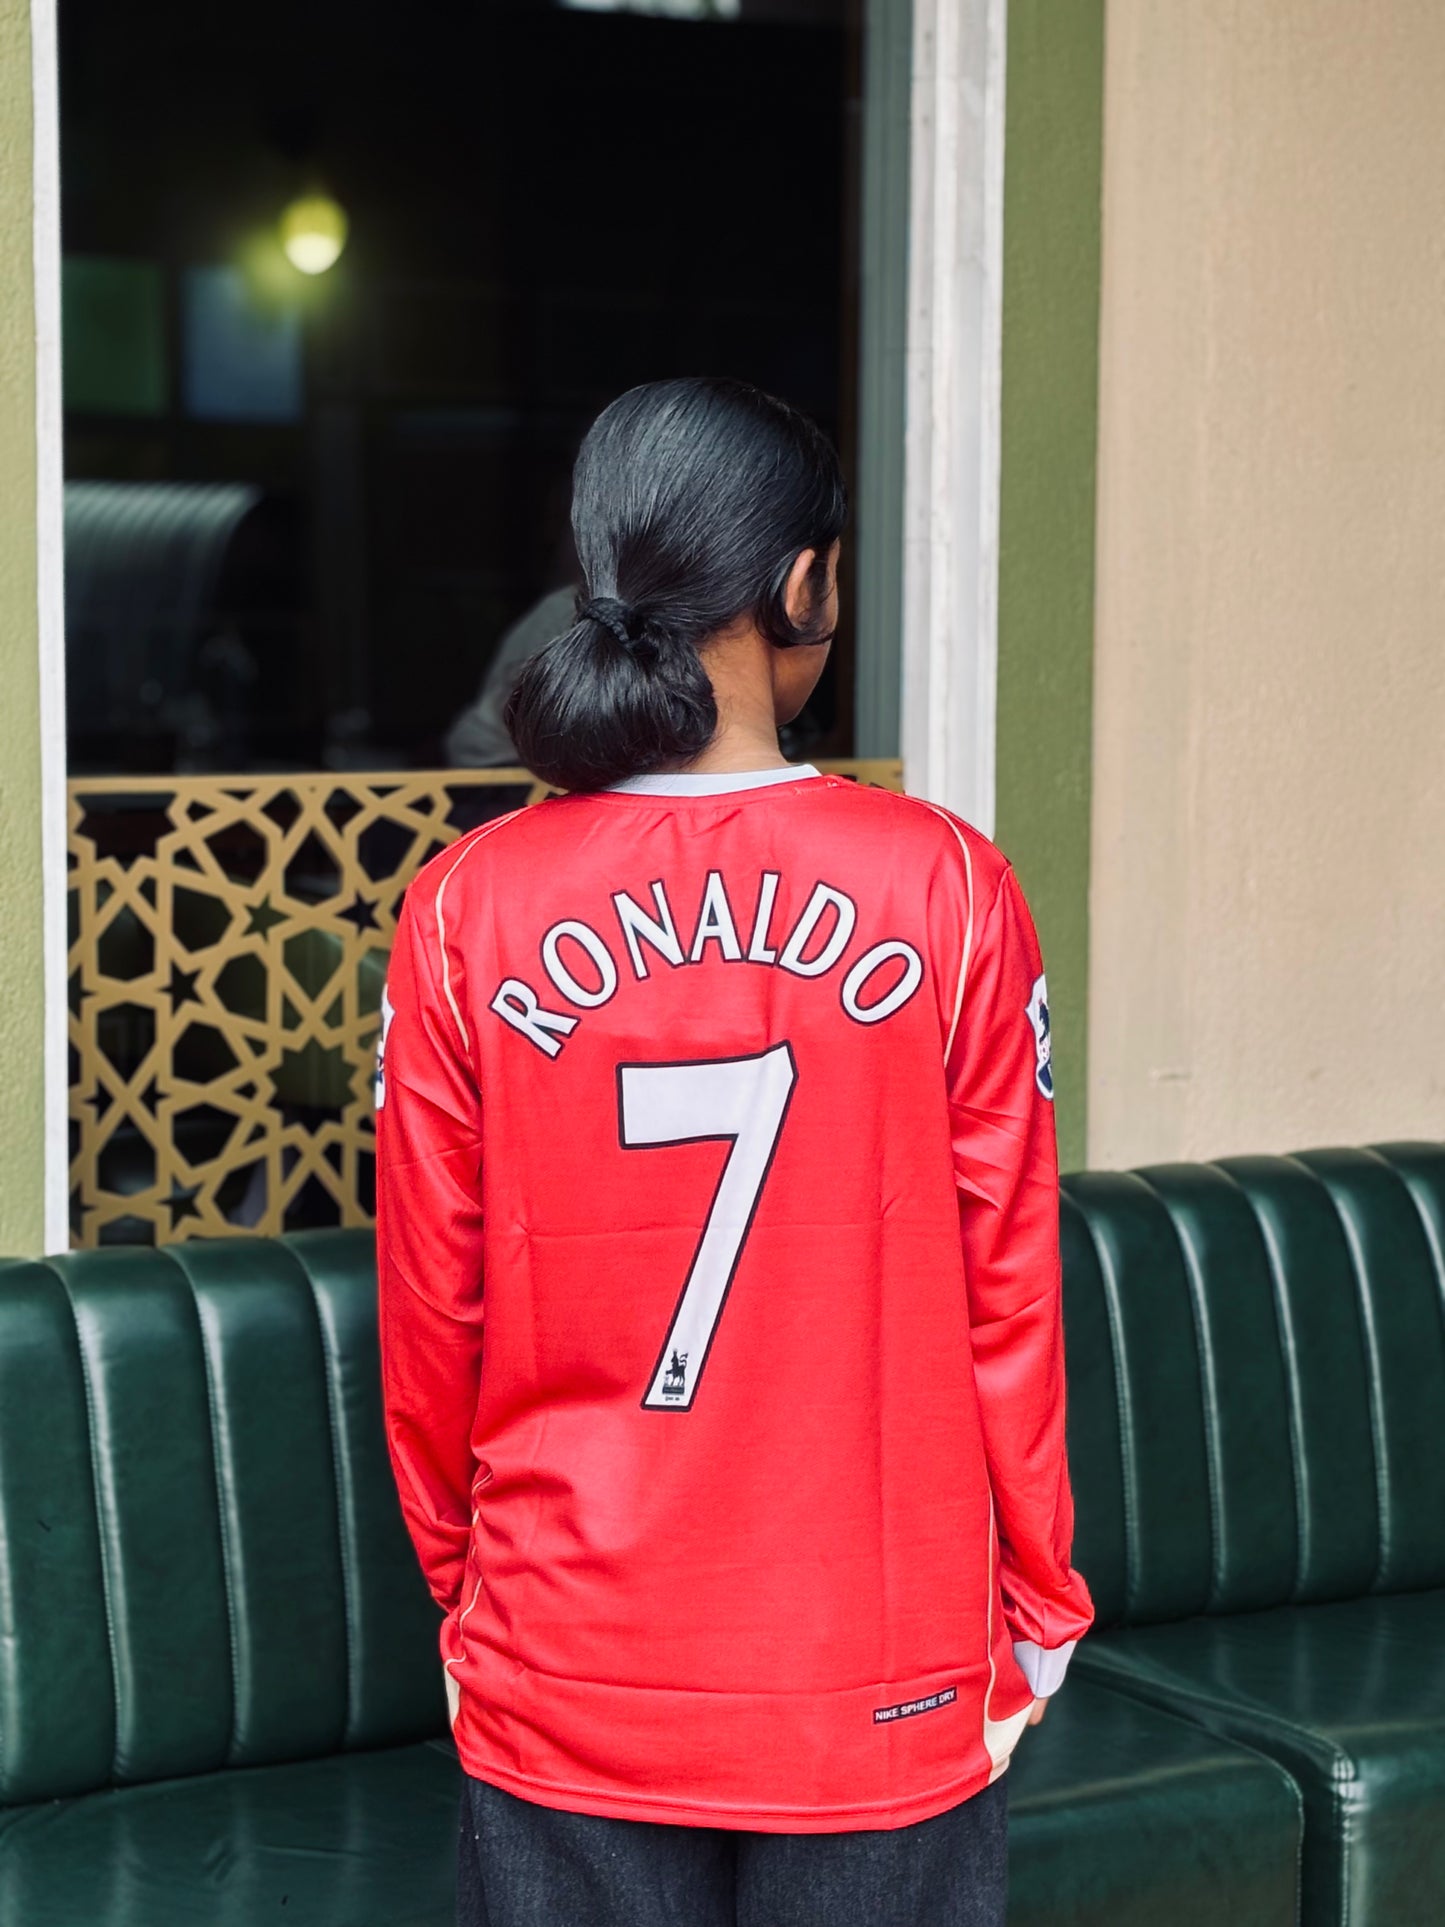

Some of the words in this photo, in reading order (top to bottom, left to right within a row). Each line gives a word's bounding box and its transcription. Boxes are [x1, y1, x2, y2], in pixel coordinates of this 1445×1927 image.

[489, 869, 924, 1060] RONALDO
[615, 1040, 799, 1412] 7
[875, 1707, 899, 1721] NIKE
[900, 1696, 938, 1716] SPHERE
[938, 1689, 955, 1704] DRY
